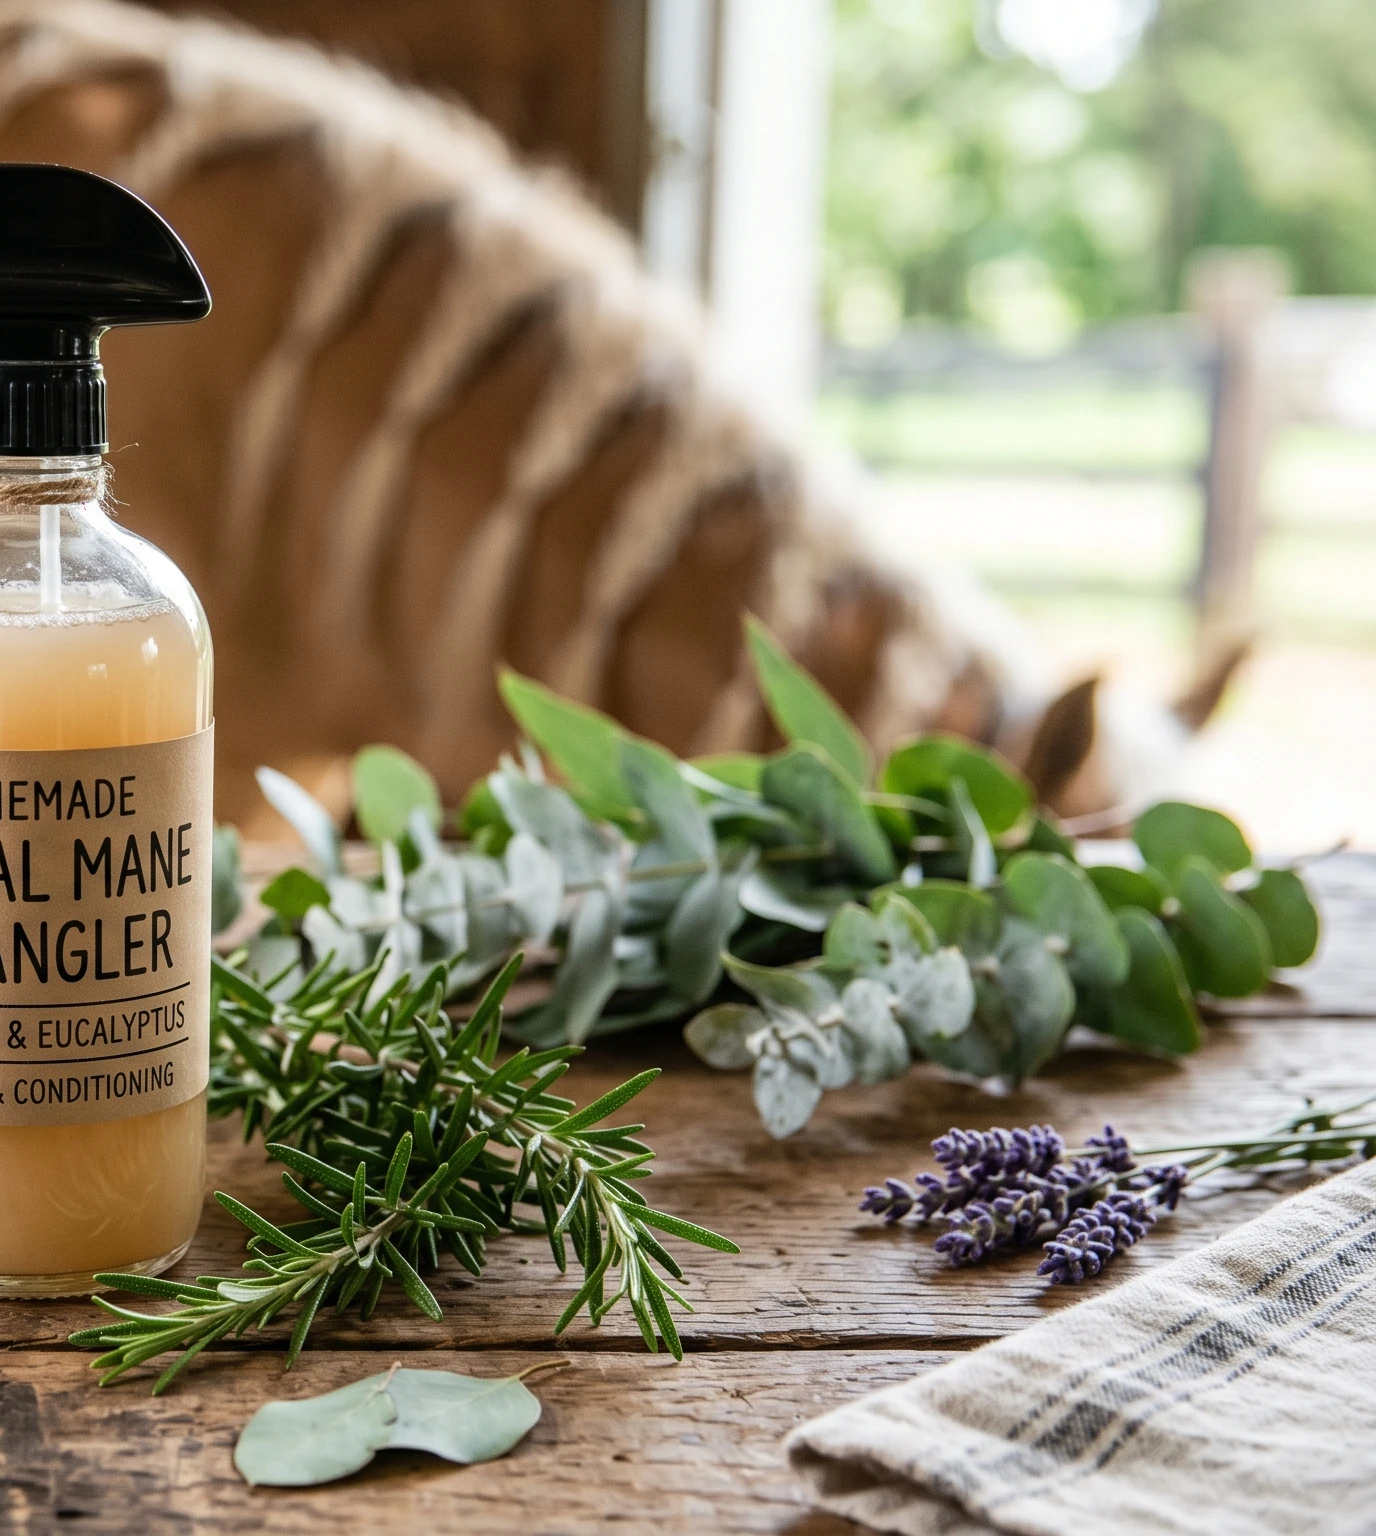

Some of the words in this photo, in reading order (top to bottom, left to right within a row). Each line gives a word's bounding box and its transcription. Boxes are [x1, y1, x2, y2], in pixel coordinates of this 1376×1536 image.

[70, 822, 192, 902] MANE
[6, 1019, 28, 1050] &
[38, 999, 186, 1049] EUCALYPTUS
[13, 1061, 174, 1105] CONDITIONING
